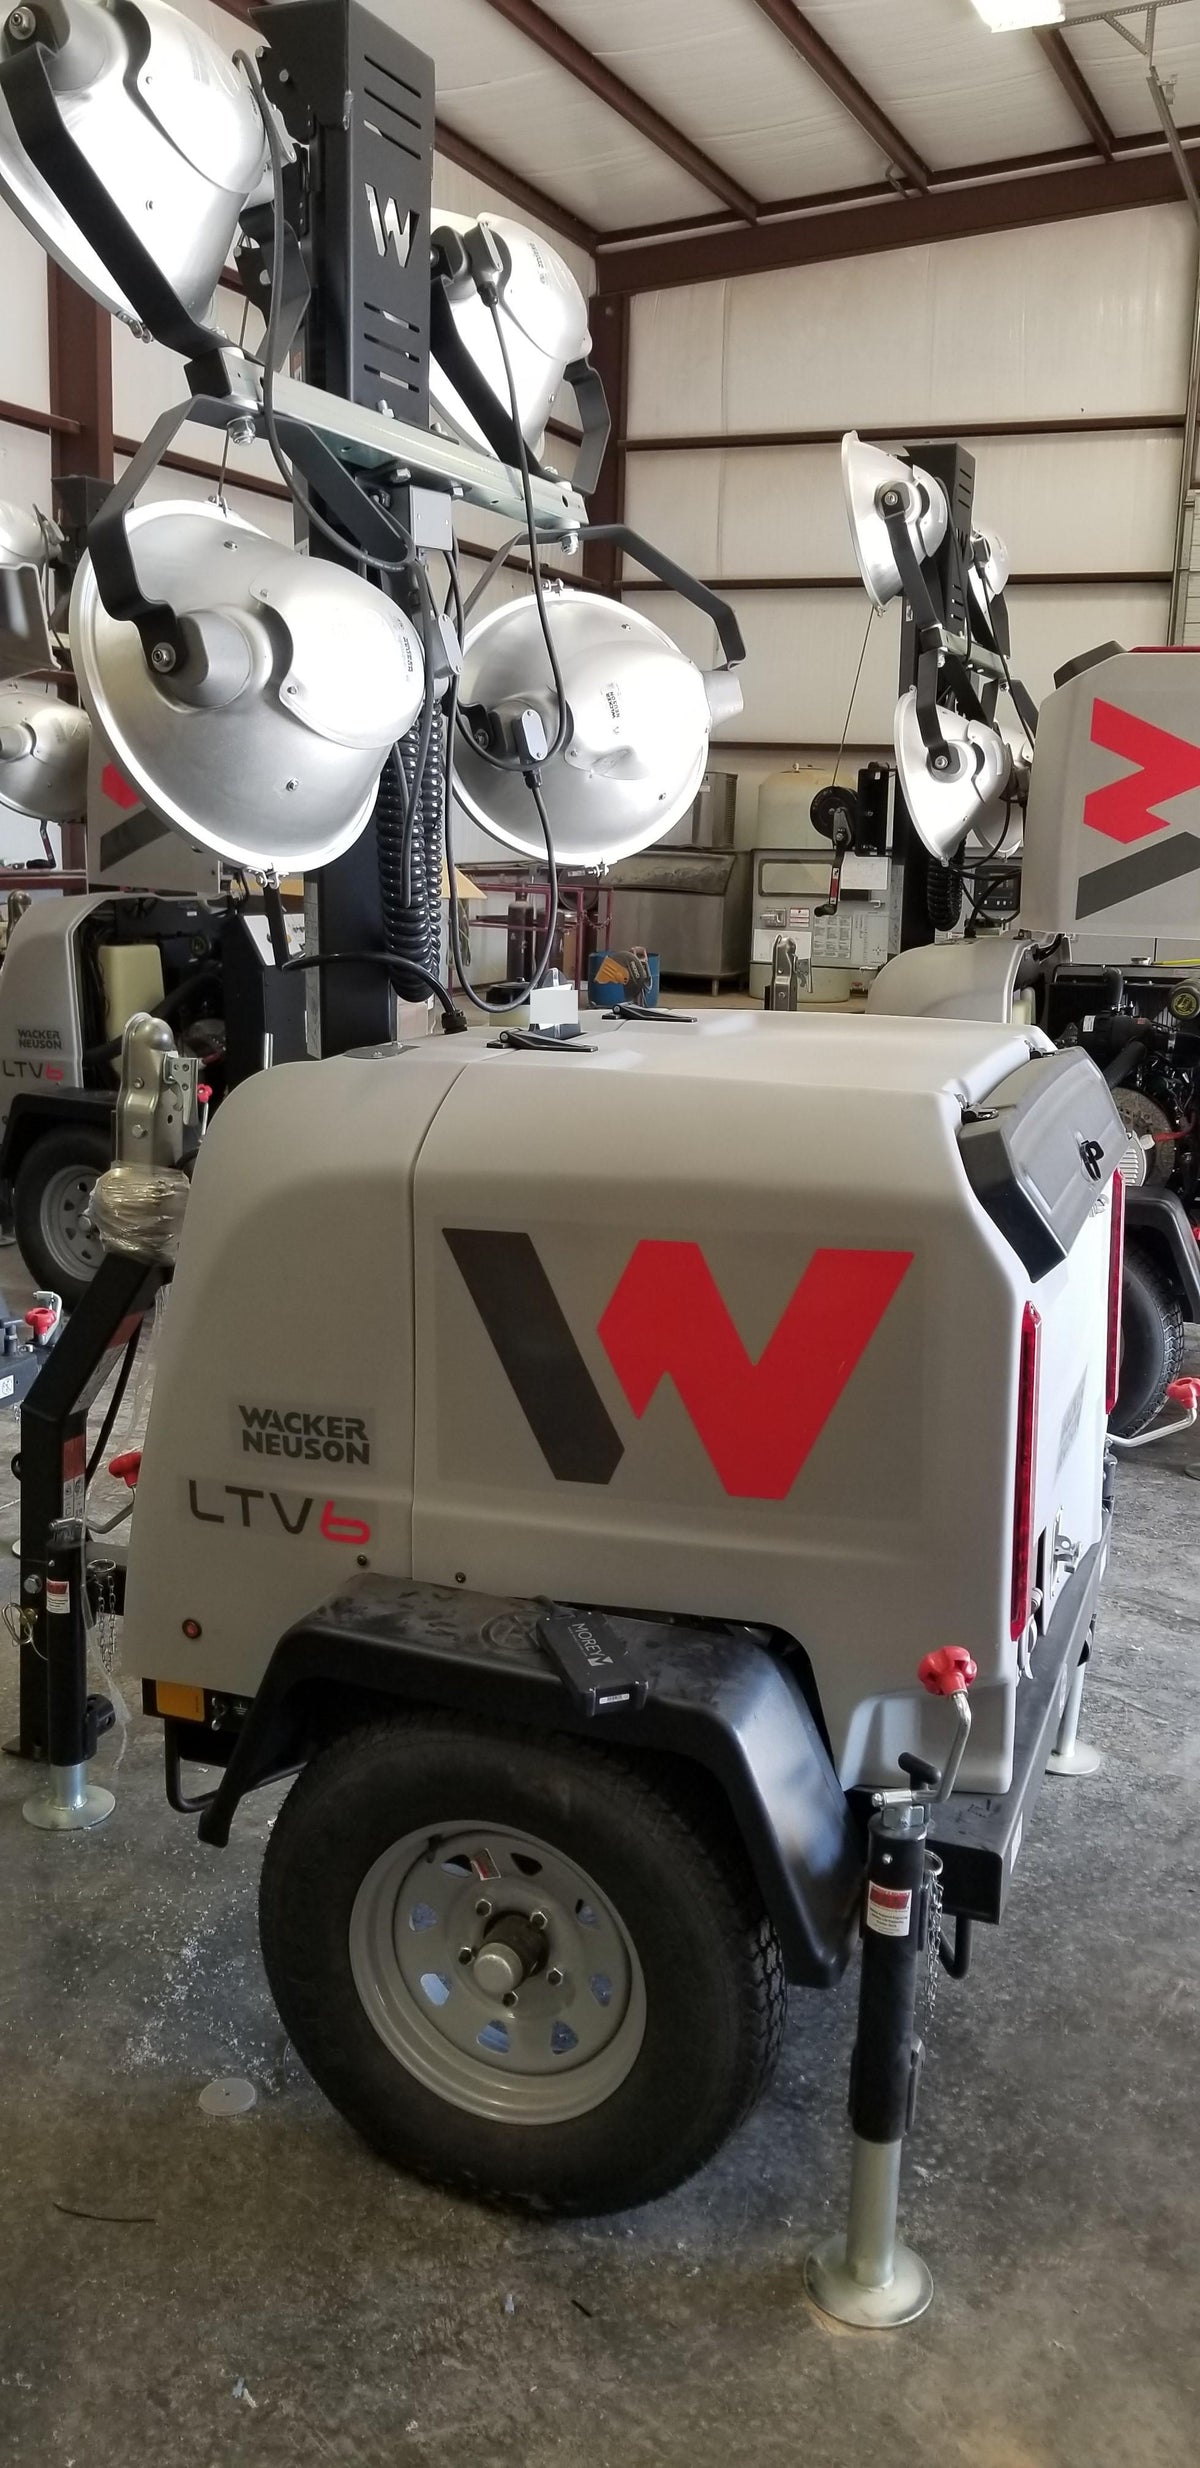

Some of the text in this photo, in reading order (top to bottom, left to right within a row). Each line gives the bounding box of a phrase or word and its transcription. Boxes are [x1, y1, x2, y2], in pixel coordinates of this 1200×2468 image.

[17, 1028, 60, 1040] WACKER
[19, 1039, 62, 1050] NEUSON
[2, 1060, 64, 1081] LTV6
[442, 1228, 914, 1501] W
[238, 1404, 368, 1441] WACKER
[242, 1429, 370, 1465] NEUSON
[189, 1479, 371, 1545] LTV6
[572, 1623, 605, 1656] MOREY
